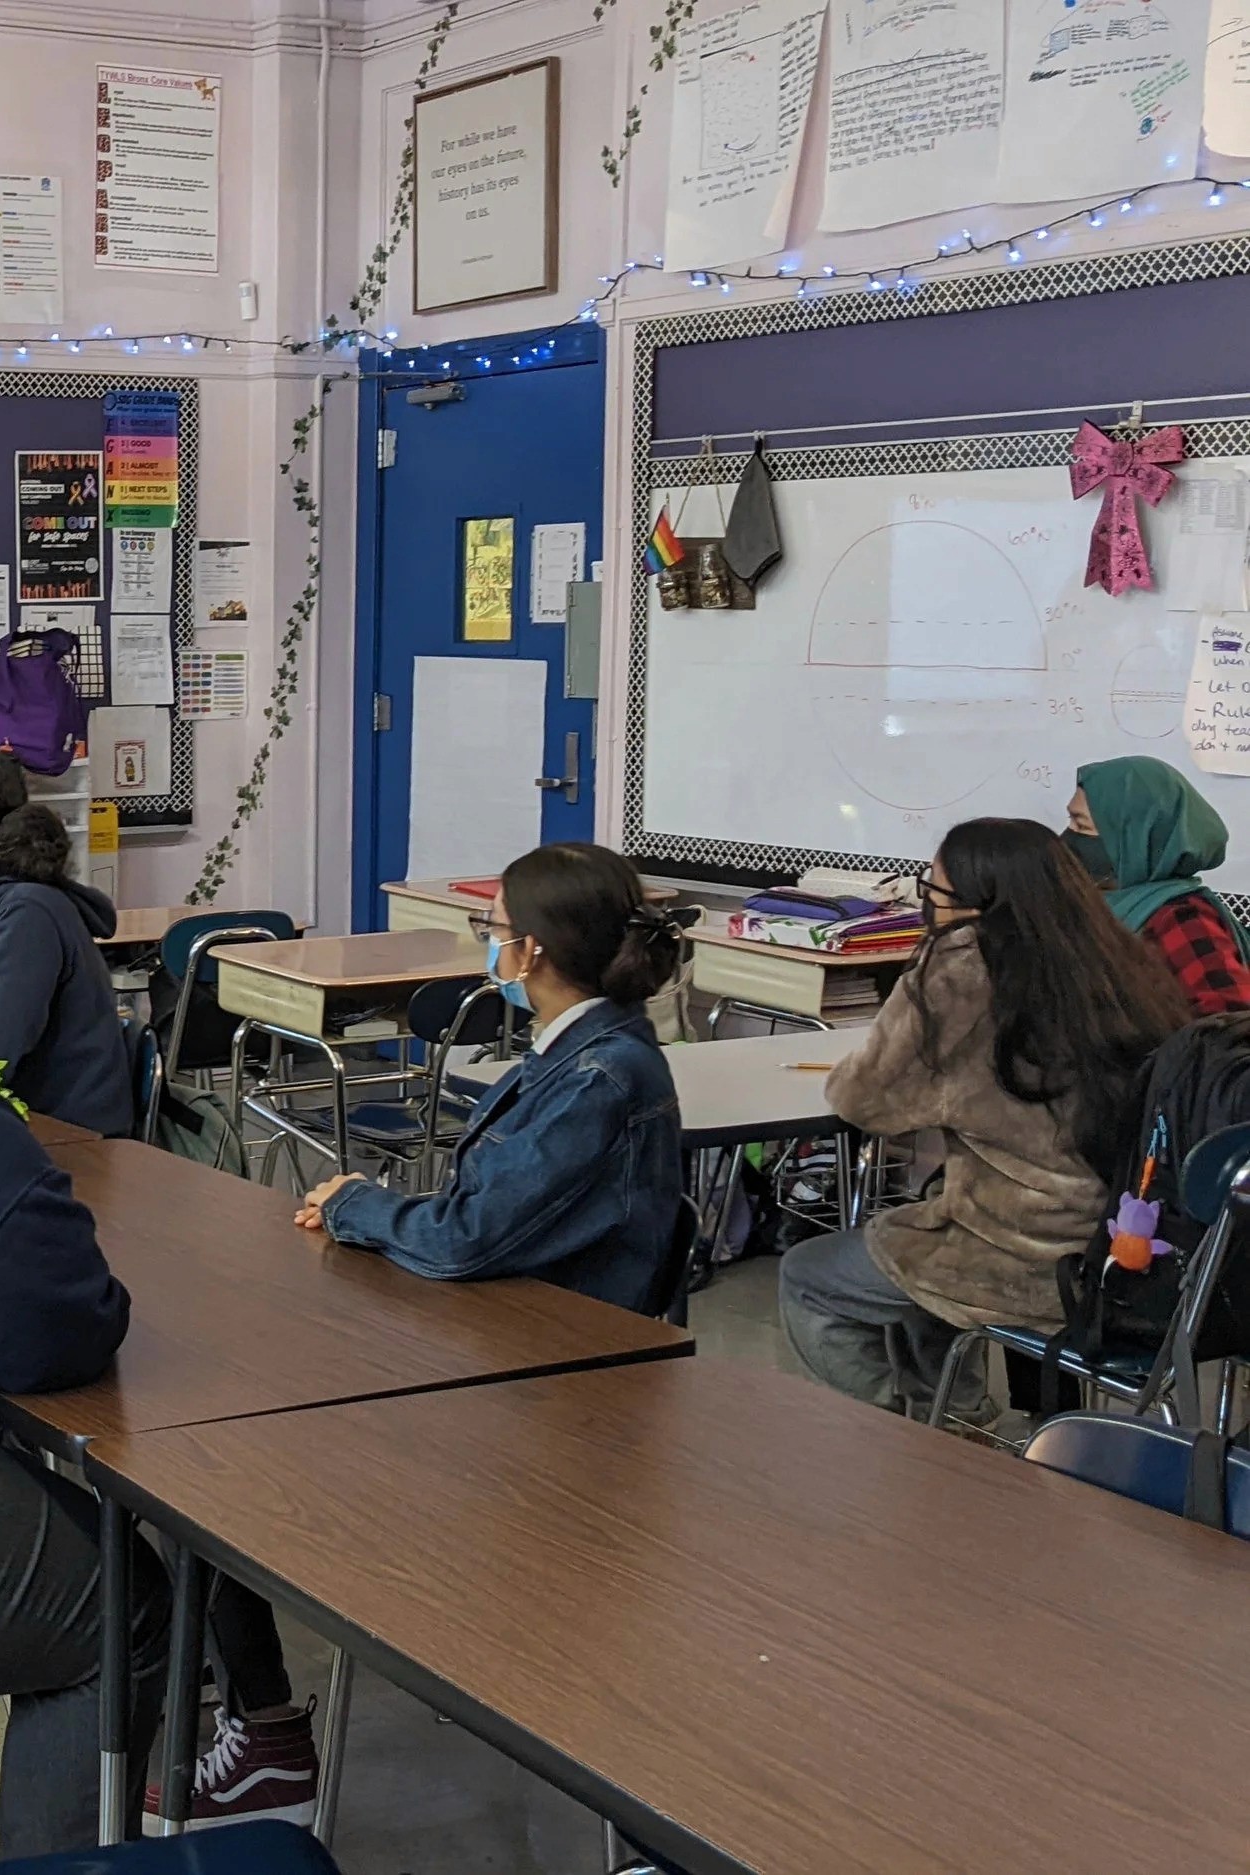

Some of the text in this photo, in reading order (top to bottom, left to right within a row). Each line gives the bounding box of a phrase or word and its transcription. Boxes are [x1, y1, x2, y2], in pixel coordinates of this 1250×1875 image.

[441, 125, 517, 152] For while we have
[431, 168, 446, 179] our
[447, 163, 467, 178] eyes
[469, 160, 479, 170] on
[481, 155, 495, 167] the
[438, 176, 519, 202] history has its eyes
[466, 210, 476, 220] on
[106, 439, 114, 453] G
[106, 461, 113, 475] A
[107, 485, 114, 498] N
[22, 517, 96, 529] COME OUT
